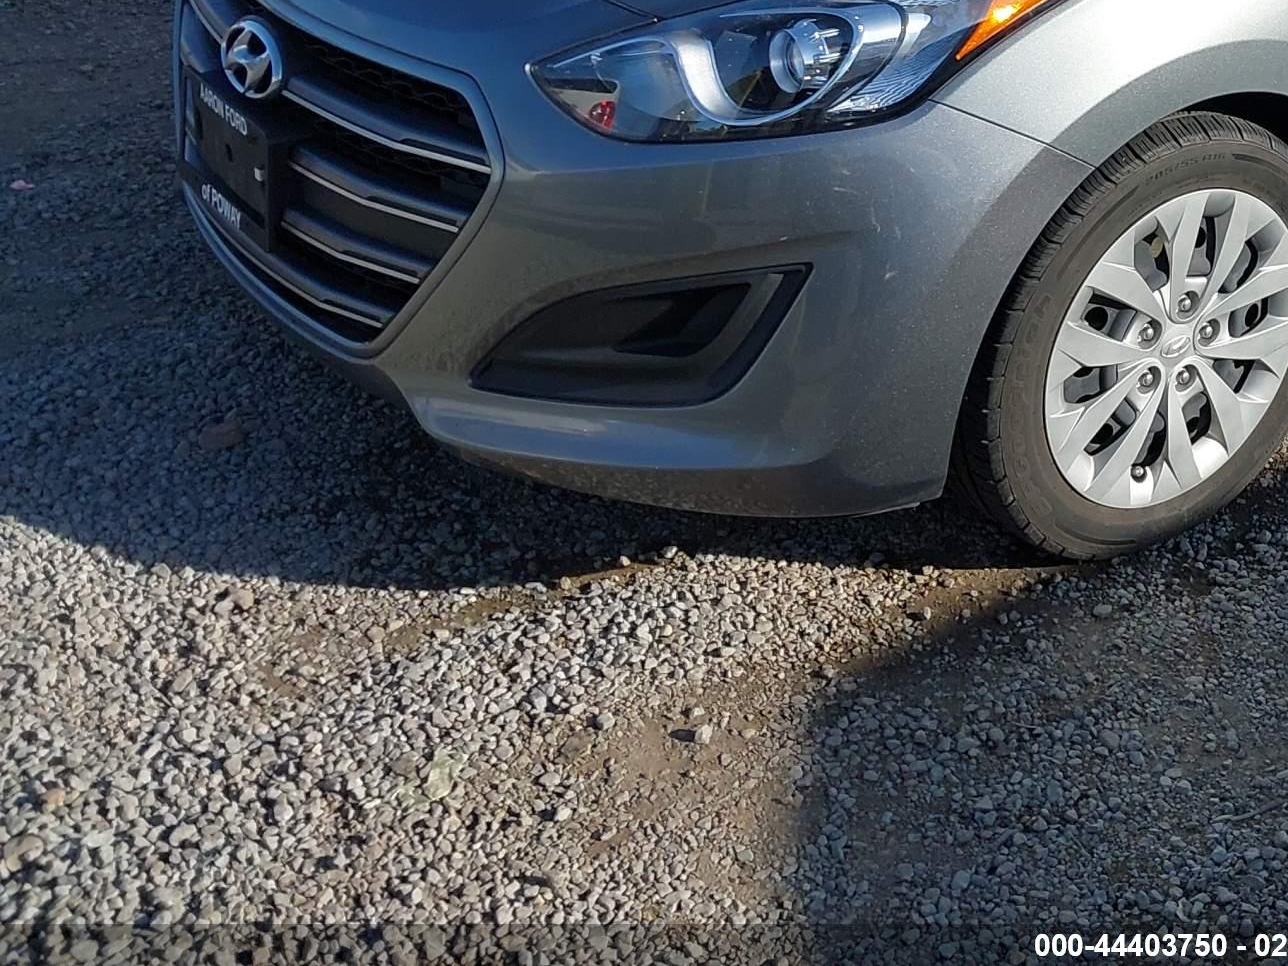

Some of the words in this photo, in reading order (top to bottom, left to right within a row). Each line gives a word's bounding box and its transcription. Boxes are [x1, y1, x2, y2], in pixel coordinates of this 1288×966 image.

[199, 82, 225, 119] AARON
[225, 104, 248, 136] FORD
[201, 183, 211, 202] of
[211, 187, 241, 230] POWAY
